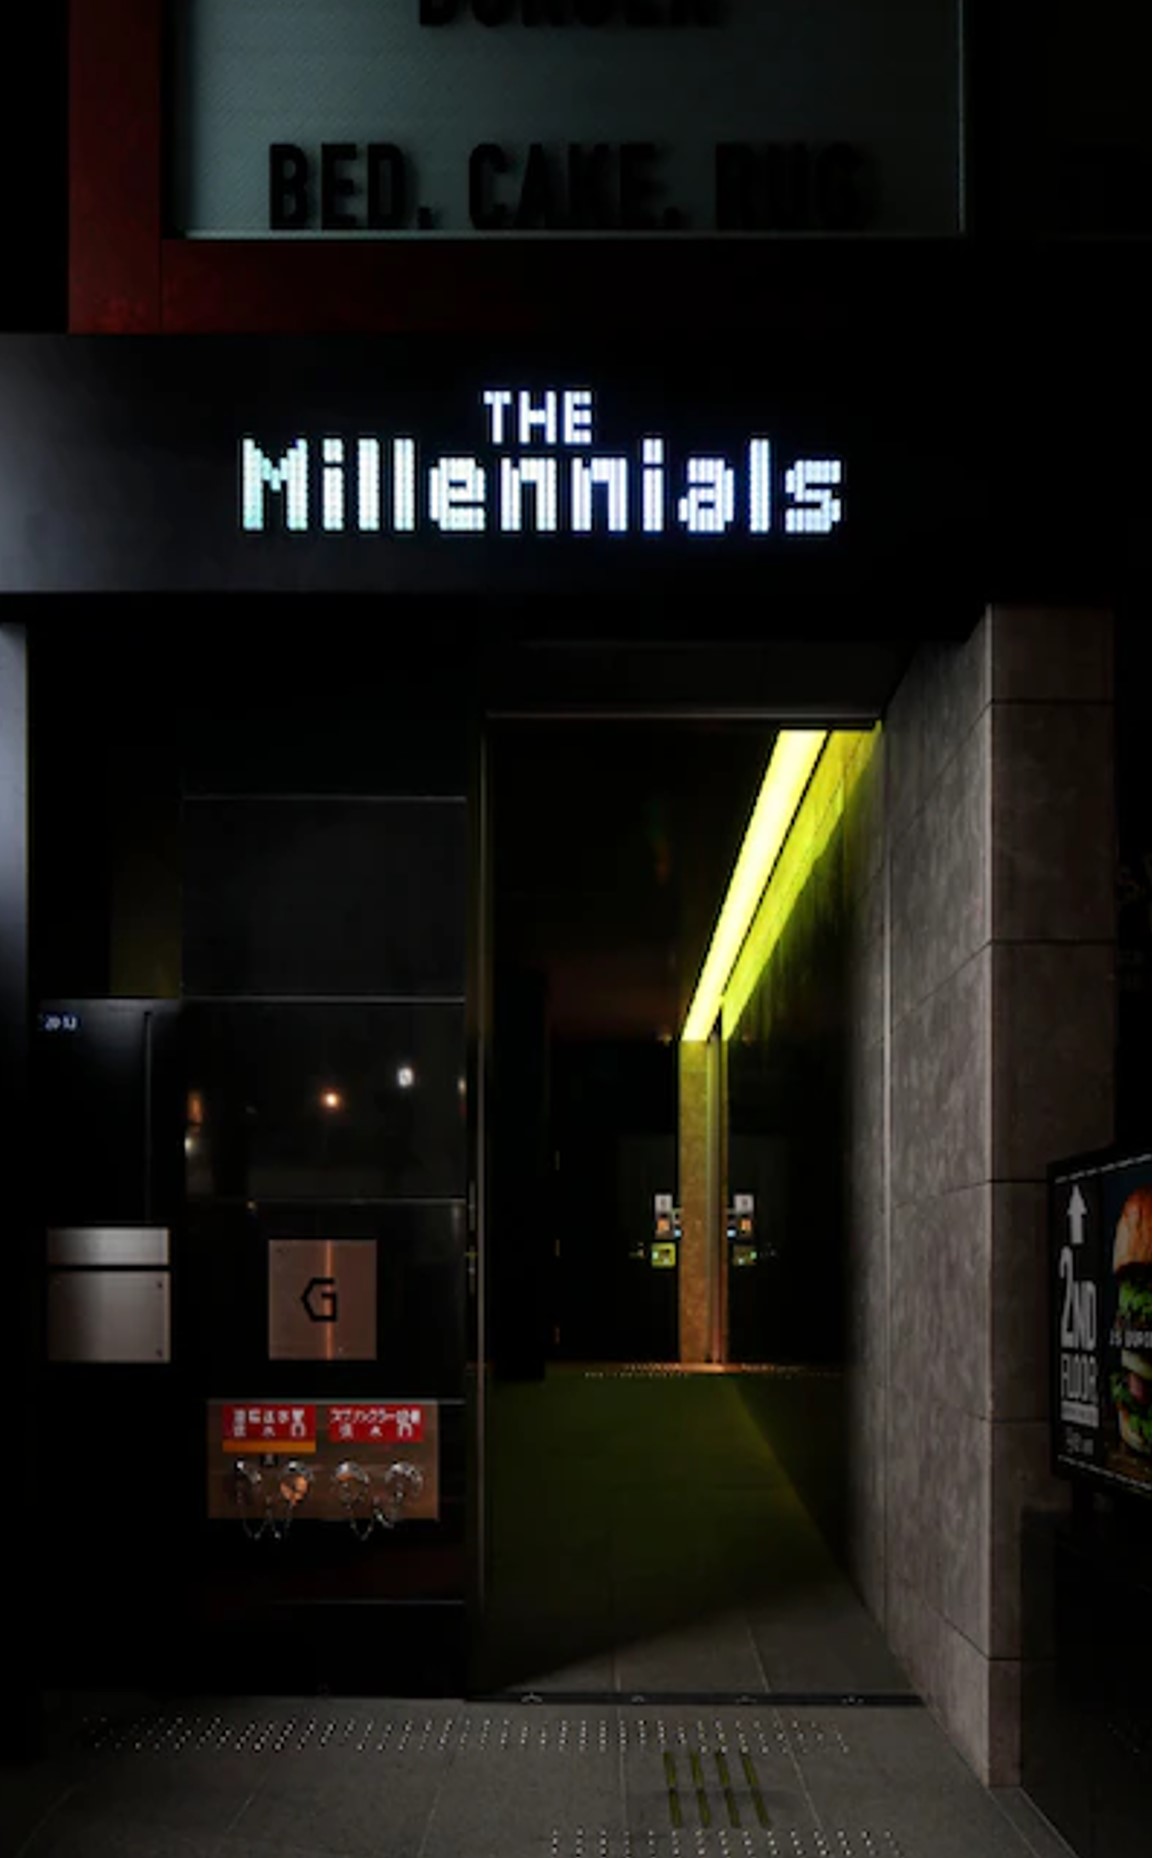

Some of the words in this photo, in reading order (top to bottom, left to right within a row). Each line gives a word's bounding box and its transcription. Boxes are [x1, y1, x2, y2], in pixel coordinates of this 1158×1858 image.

[483, 390, 592, 444] THE
[241, 438, 842, 532] Millennials
[300, 1277, 337, 1322] G
[1059, 1244, 1098, 1351] 2ND
